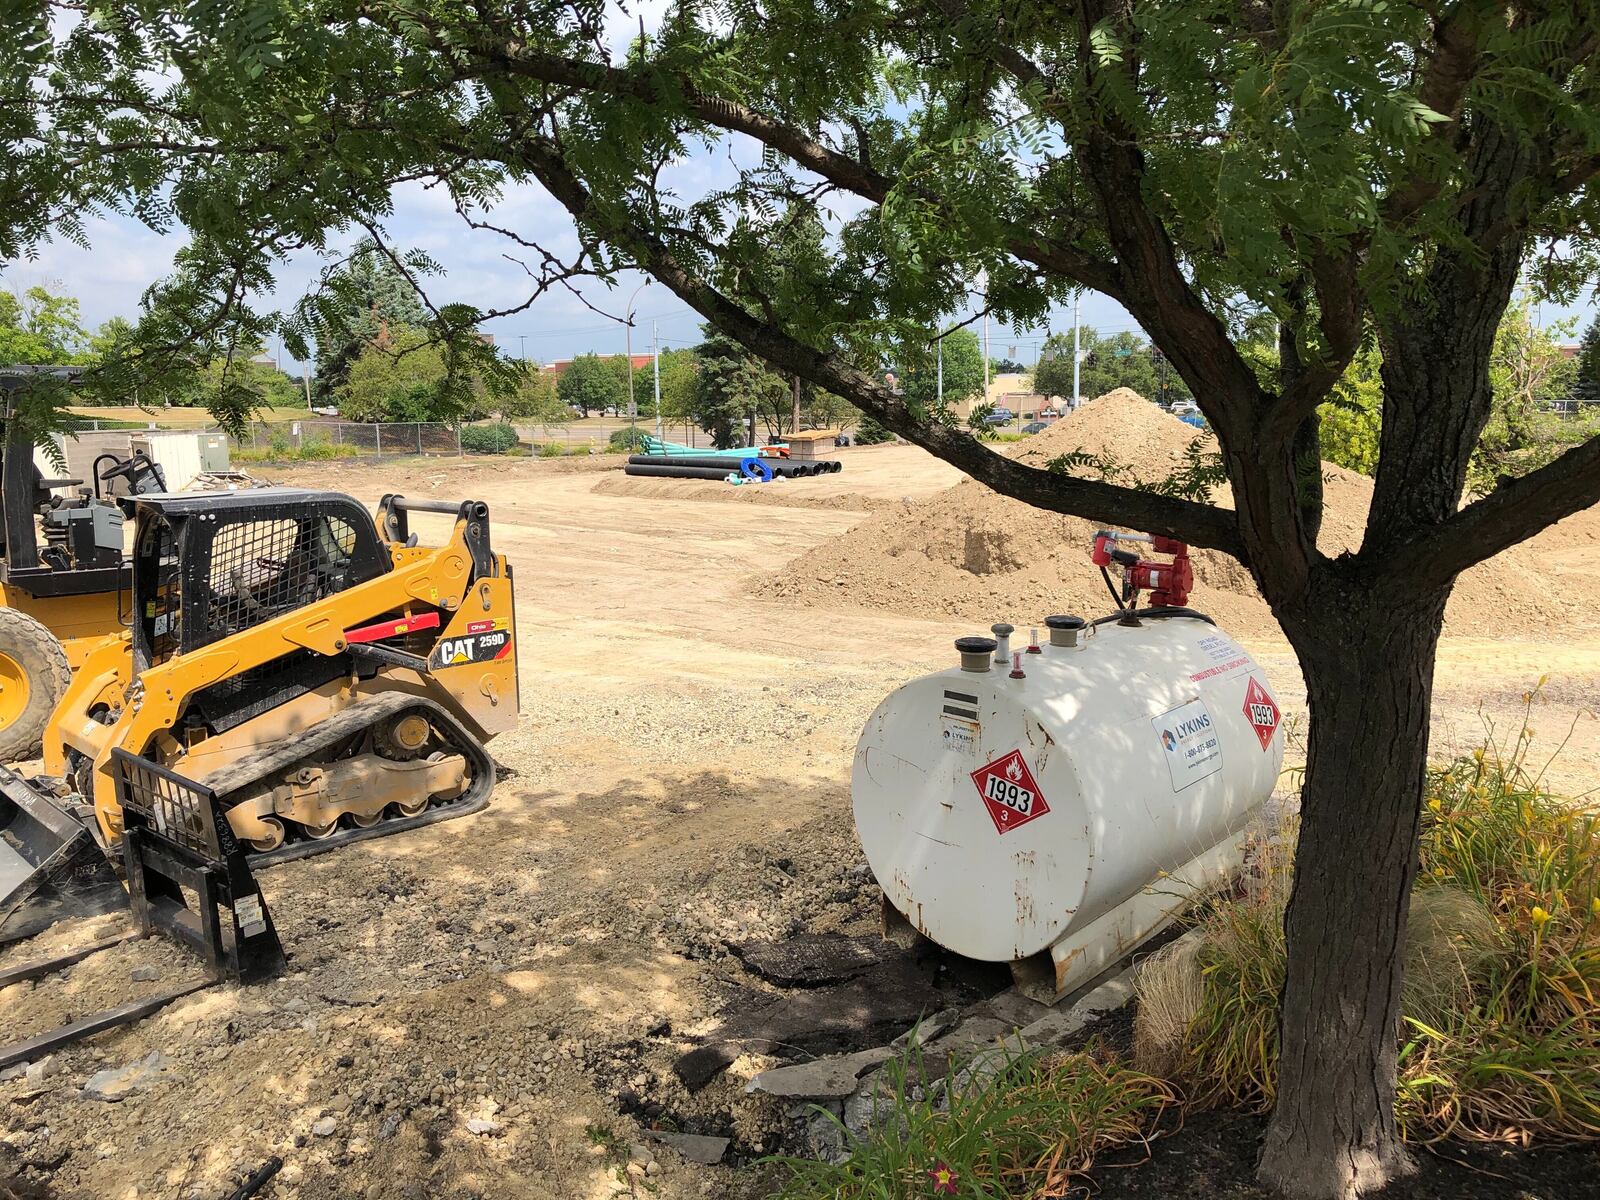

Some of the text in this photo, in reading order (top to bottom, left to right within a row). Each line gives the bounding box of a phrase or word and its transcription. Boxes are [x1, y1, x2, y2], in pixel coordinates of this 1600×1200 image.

[441, 633, 504, 665] CAT 259D
[1252, 705, 1273, 725] 1993
[1175, 713, 1210, 739] LYKINS
[1263, 729, 1267, 739] 3
[952, 732, 975, 742] LYKINS
[990, 777, 1030, 812] 1993
[1001, 810, 1008, 821] 3
